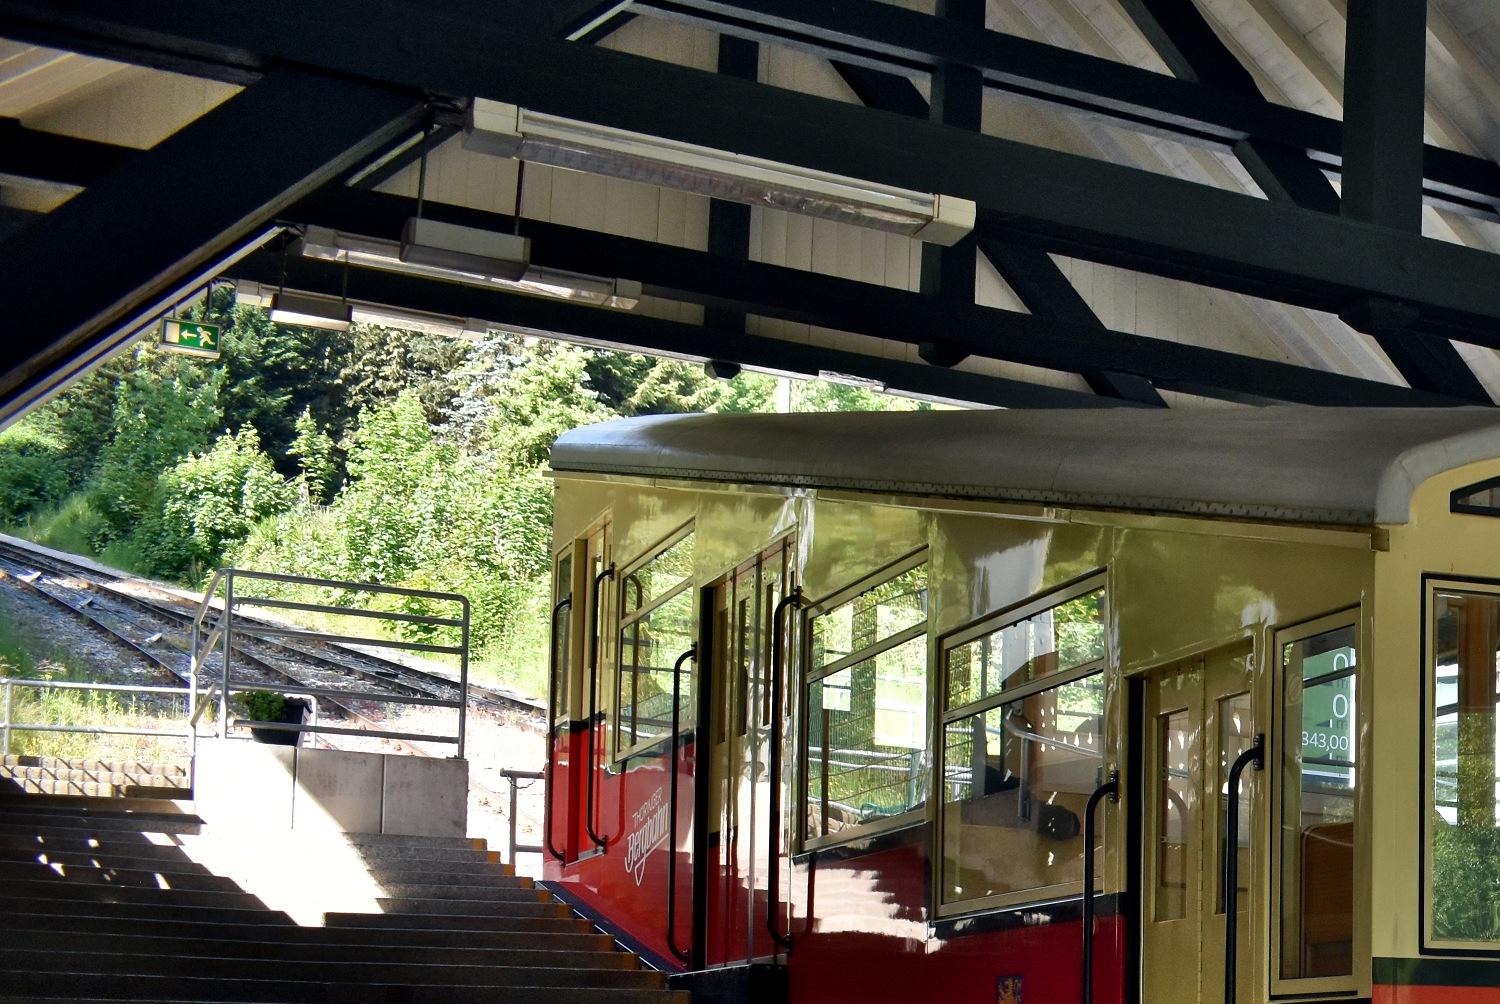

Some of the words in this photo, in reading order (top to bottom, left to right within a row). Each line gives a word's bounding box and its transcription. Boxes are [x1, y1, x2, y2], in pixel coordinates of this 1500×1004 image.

[1333, 653, 1349, 672] 0
[1332, 693, 1349, 719] 0
[624, 802, 669, 887] Bergbahn
